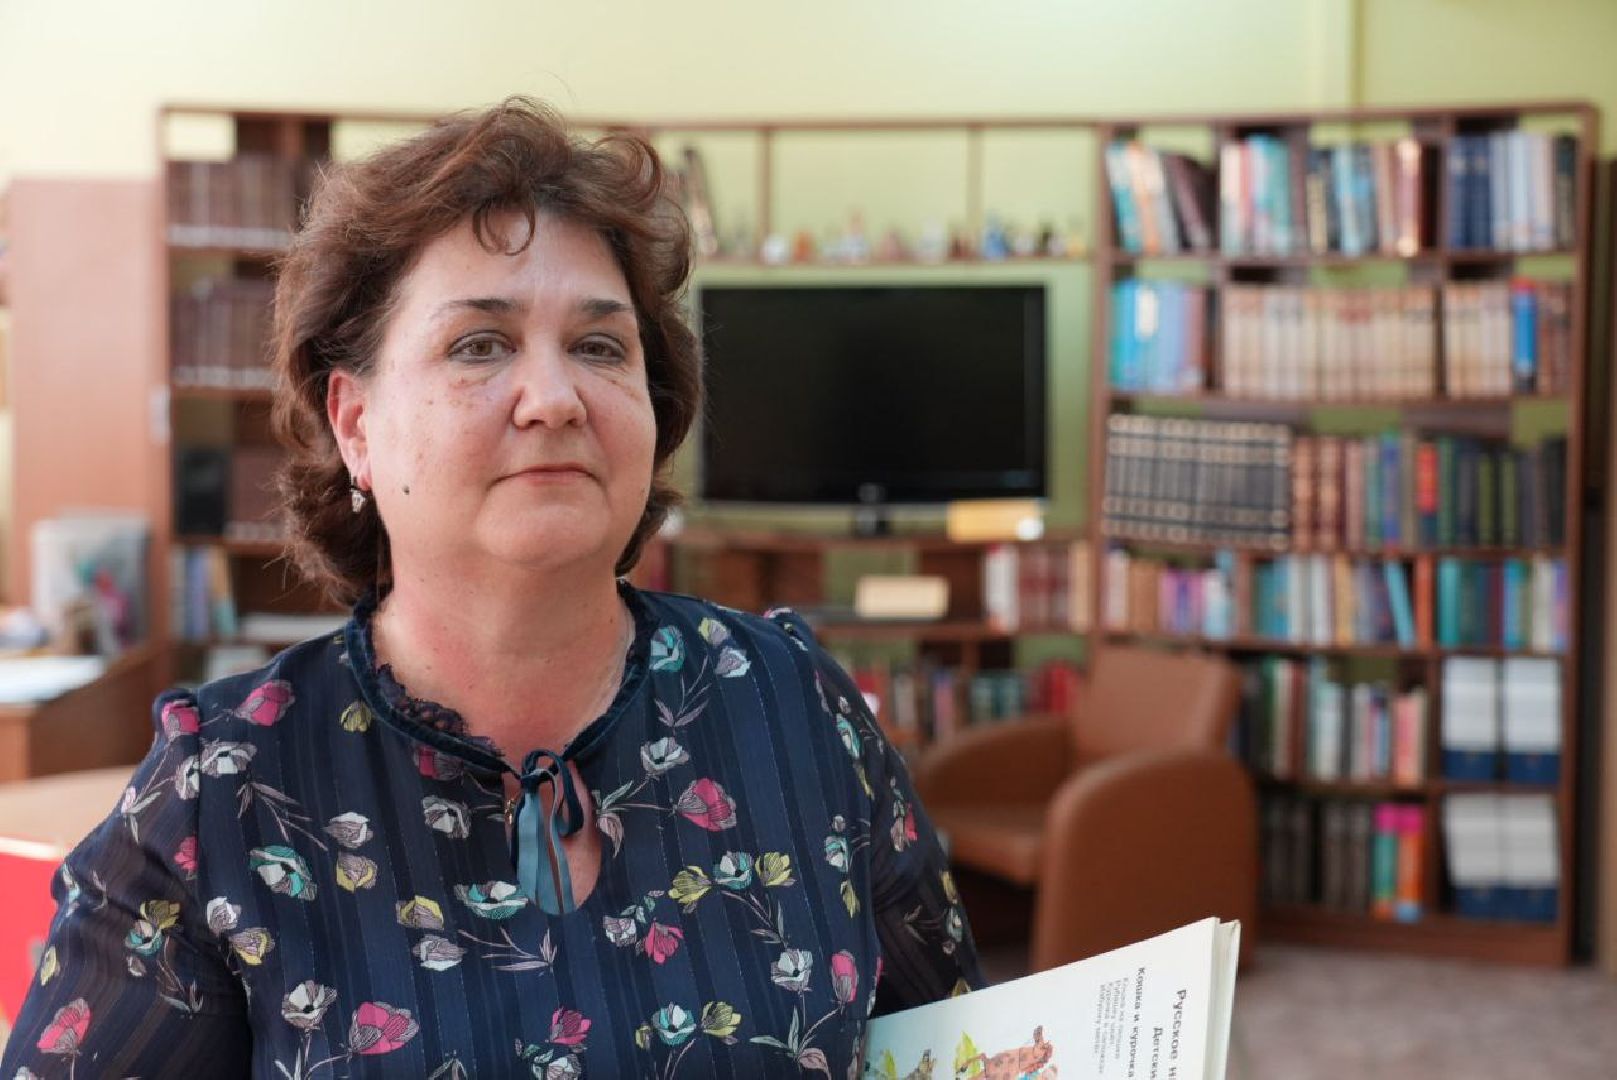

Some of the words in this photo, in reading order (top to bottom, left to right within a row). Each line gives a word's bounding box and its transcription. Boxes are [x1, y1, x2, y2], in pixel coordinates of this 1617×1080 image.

[1134, 967, 1145, 1010] Кошка
[1171, 989, 1187, 1060] Русское
[1128, 1026, 1139, 1077] курочка
[1151, 1027, 1164, 1080] Детски
